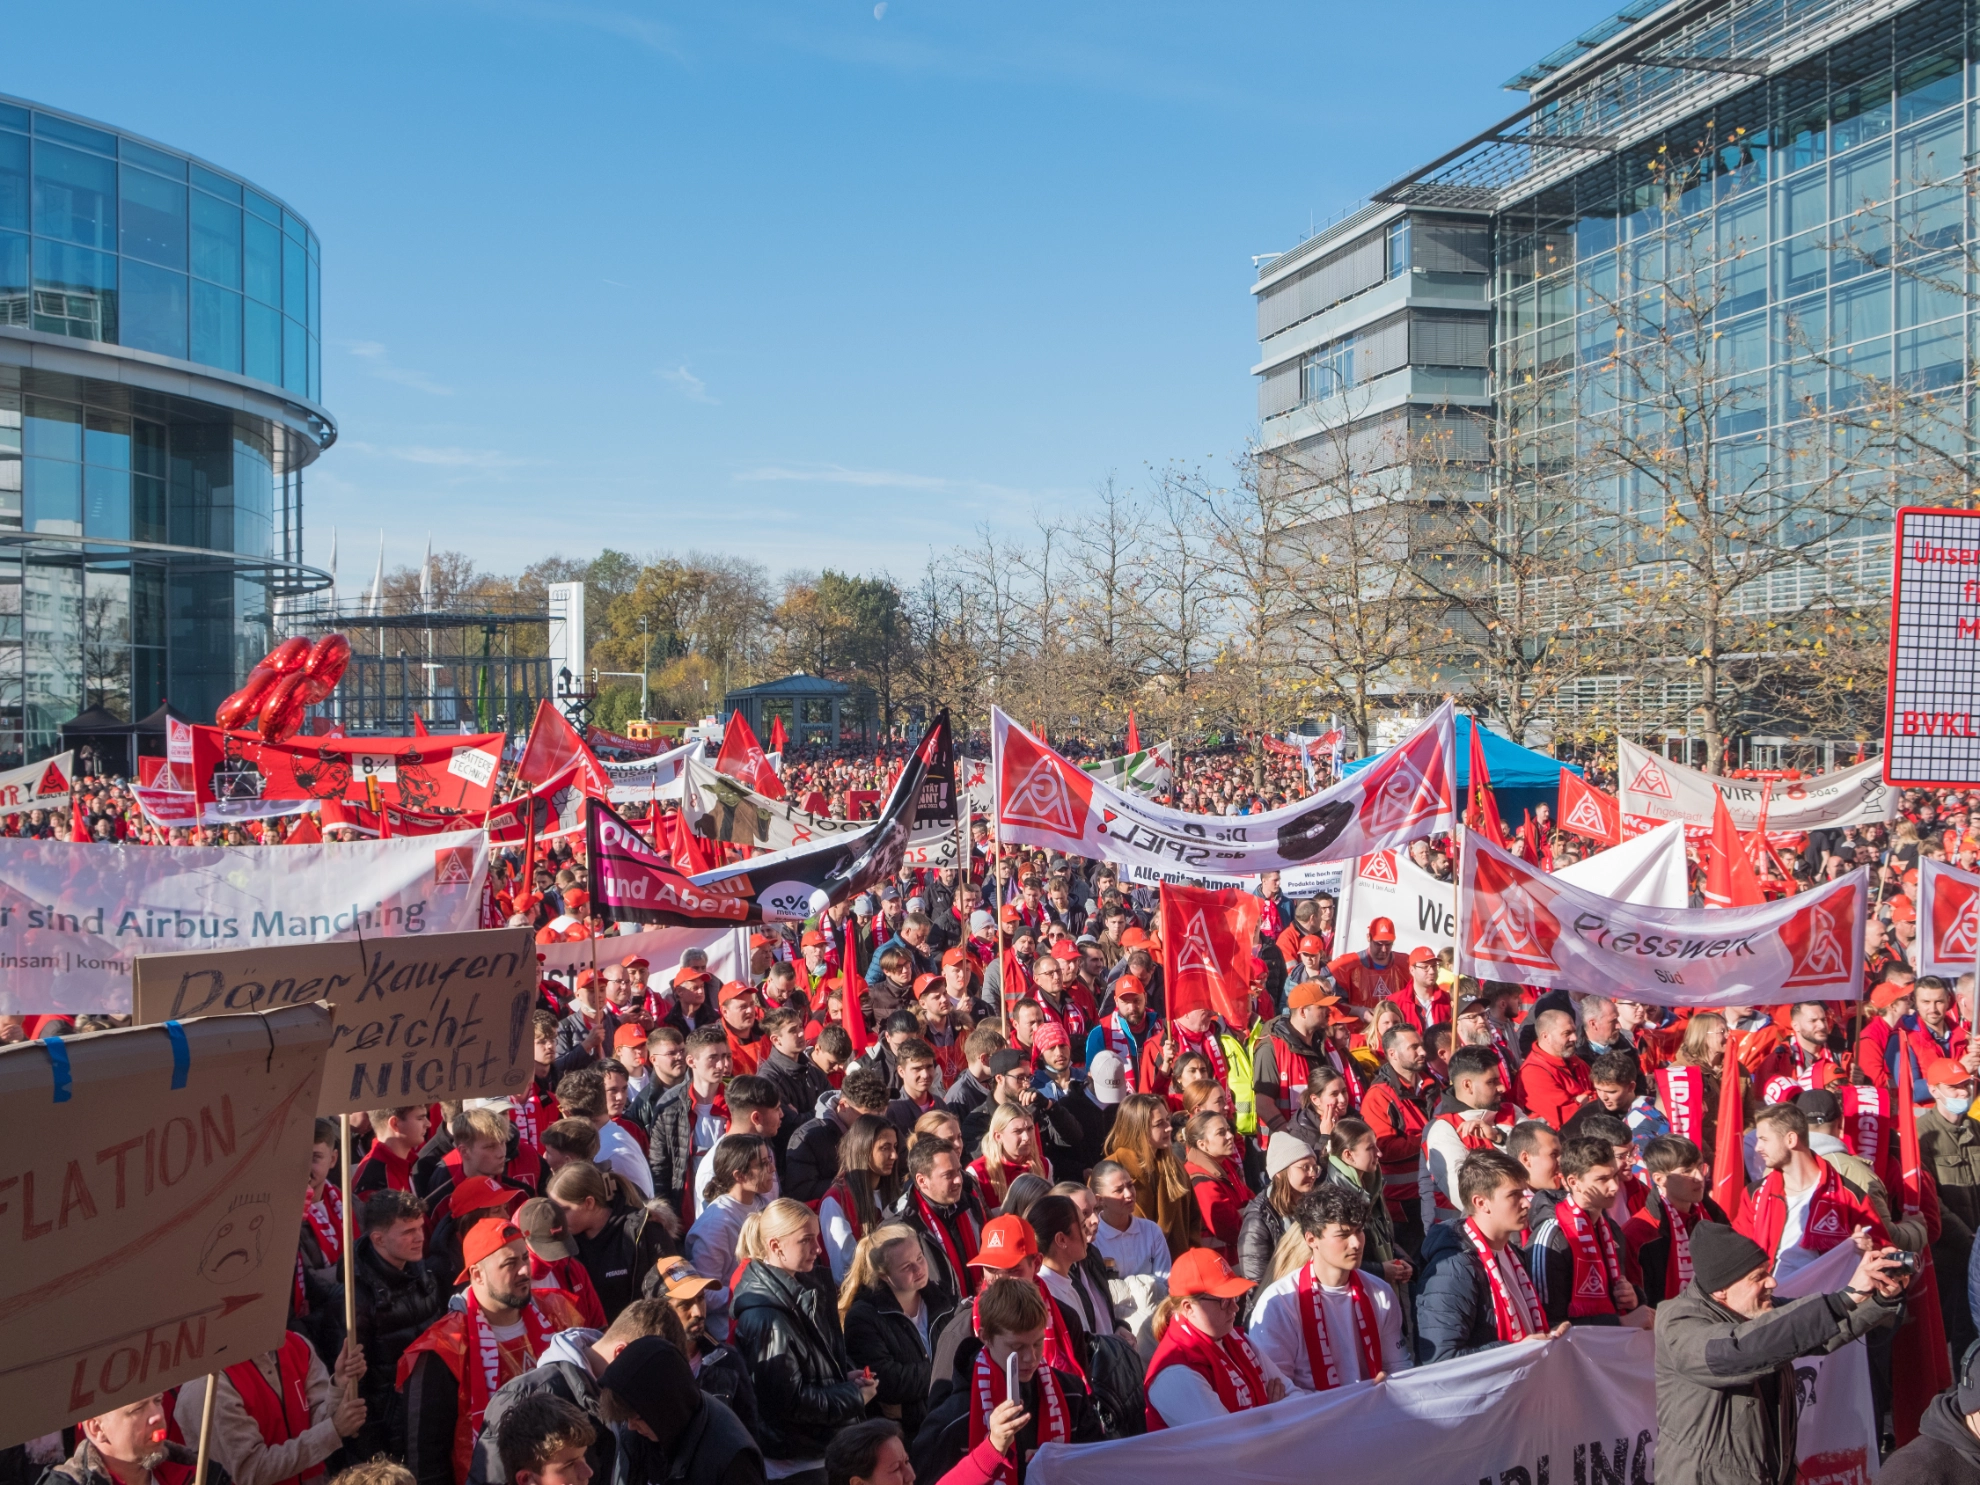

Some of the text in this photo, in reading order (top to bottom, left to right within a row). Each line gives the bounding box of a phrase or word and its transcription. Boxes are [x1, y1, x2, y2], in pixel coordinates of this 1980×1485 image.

[1958, 617, 1980, 640] M
[1903, 710, 1977, 737] BVKL
[606, 769, 658, 780] EUSON
[1134, 866, 1161, 882] Alle
[655, 882, 741, 915] Aber!
[27, 904, 104, 935] sind
[115, 911, 239, 939] Airbus
[251, 900, 426, 938] Manching
[1573, 911, 1759, 960] Presswerk
[170, 963, 354, 1020] Döner
[1655, 968, 1686, 985] Süd
[329, 995, 484, 1053] reicht
